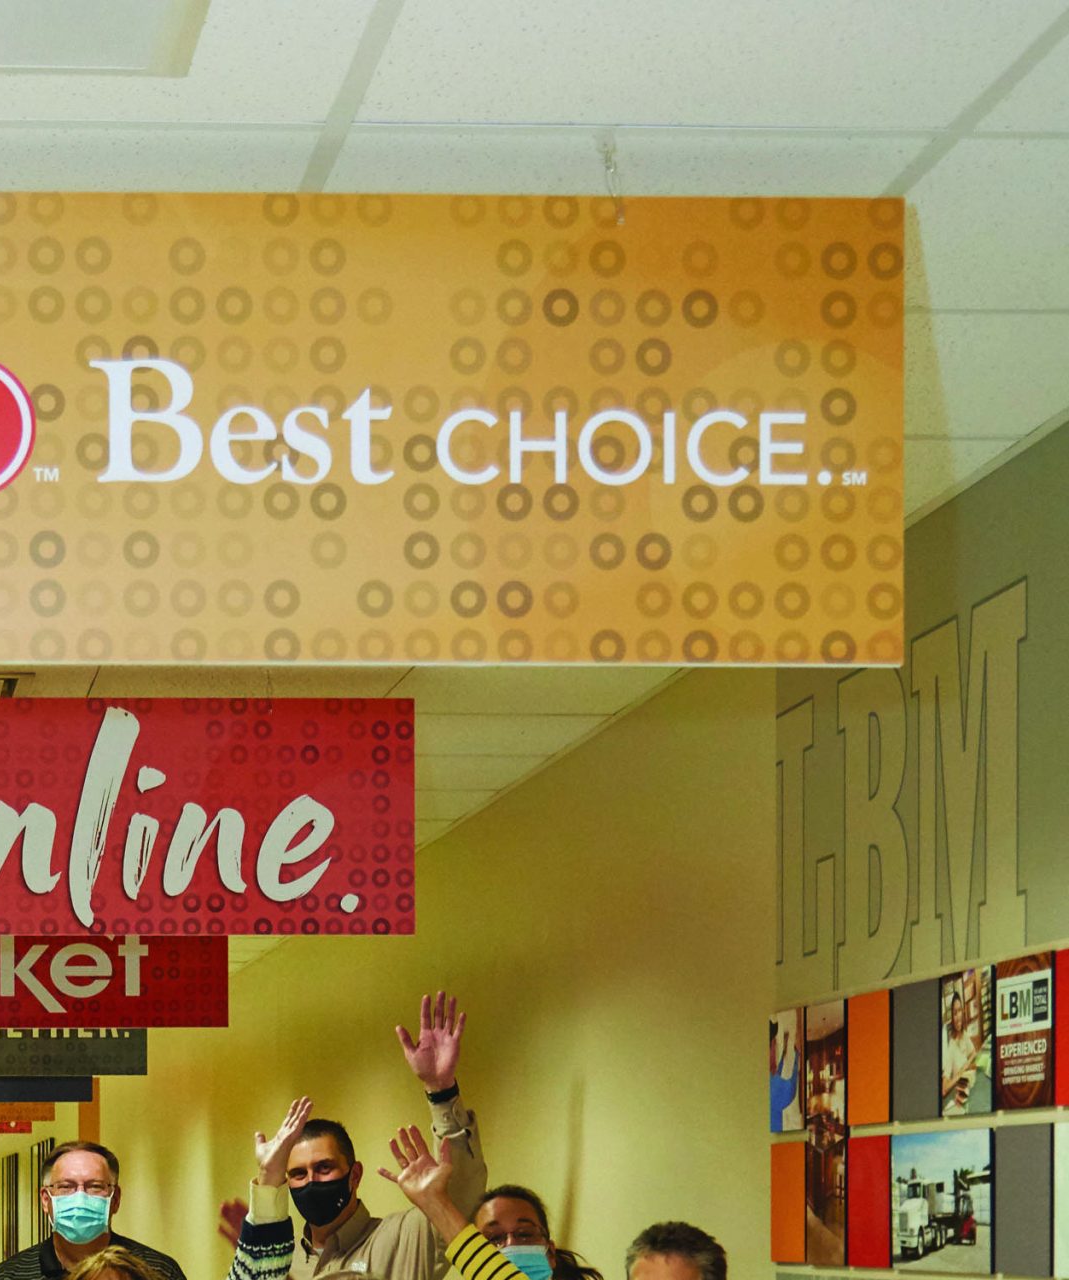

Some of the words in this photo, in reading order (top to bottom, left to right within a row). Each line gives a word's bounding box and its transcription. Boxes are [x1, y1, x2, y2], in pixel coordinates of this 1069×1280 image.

[89, 358, 395, 485] Best
[436, 409, 831, 486] CHOICE.
[1000, 988, 1031, 1021] LBM
[1000, 1038, 1047, 1059] EXPERIENCED
